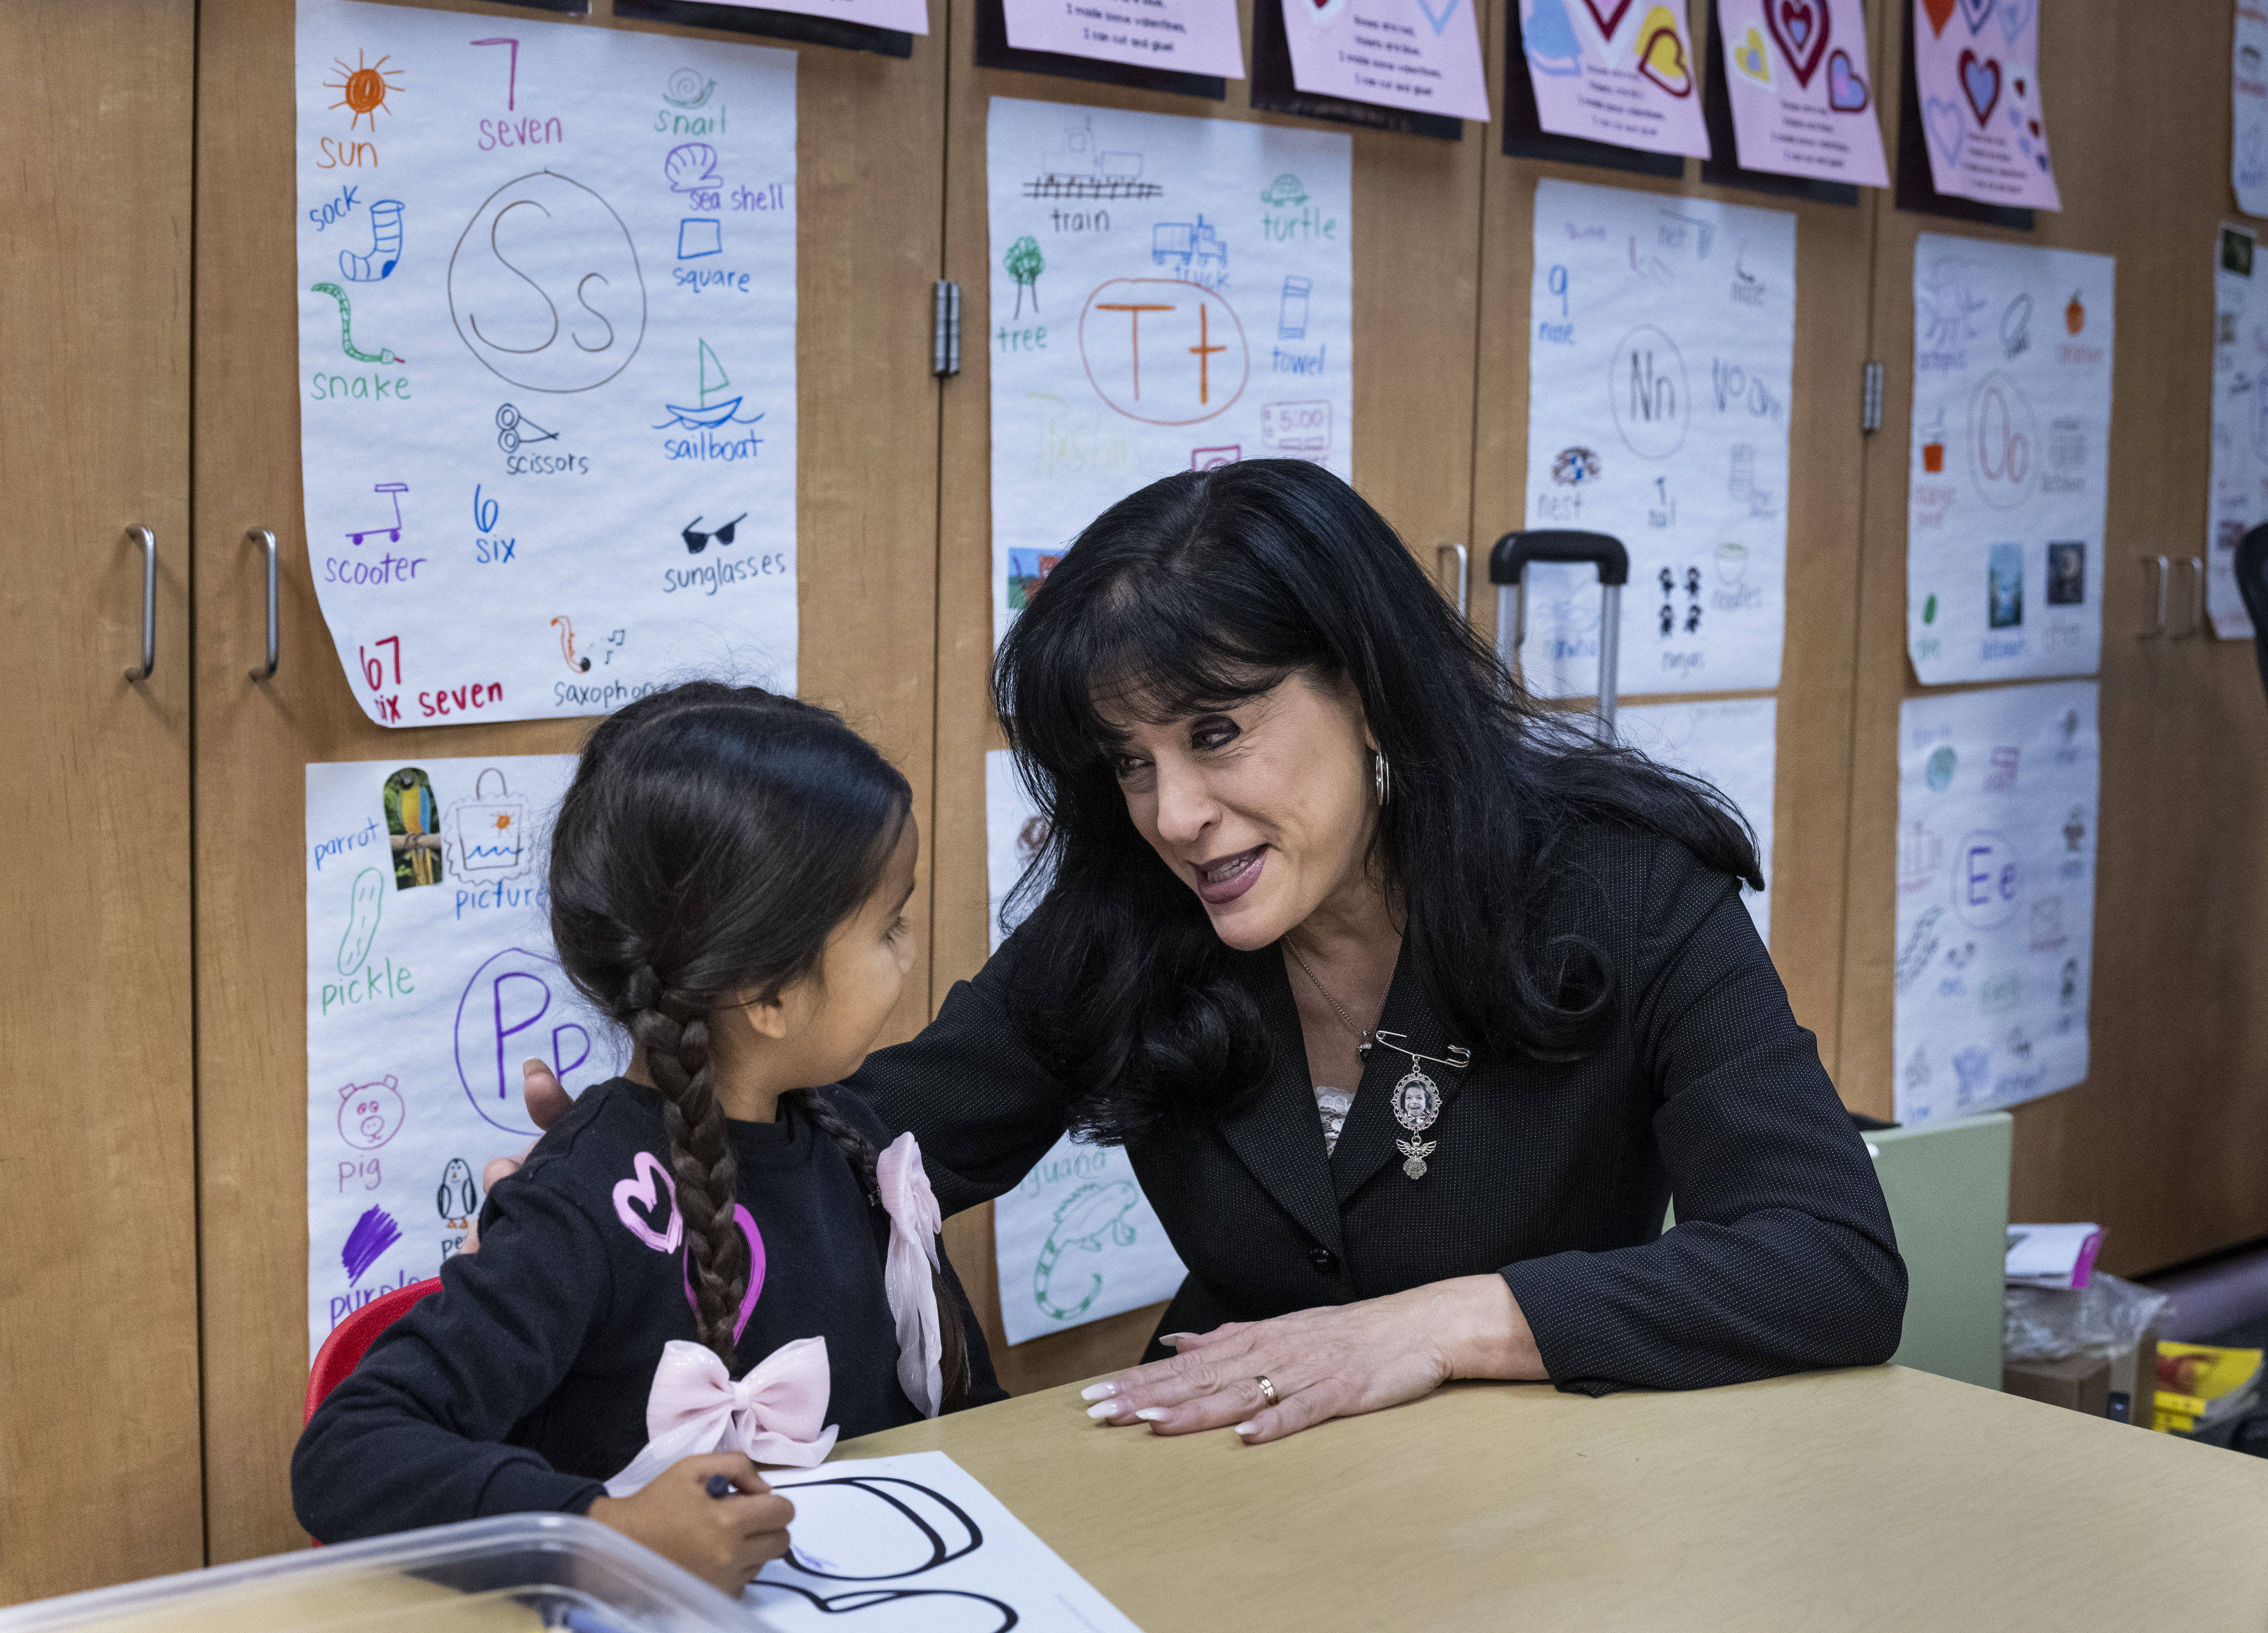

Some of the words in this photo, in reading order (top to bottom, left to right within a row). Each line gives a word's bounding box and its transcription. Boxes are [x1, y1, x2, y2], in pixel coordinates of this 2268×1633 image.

[470, 39, 518, 111] 7
[478, 115, 563, 151] seven
[654, 106, 726, 136] snail
[316, 137, 378, 168] sun
[310, 185, 362, 231] sock
[688, 189, 722, 211] sea
[731, 184, 785, 211] shell
[1050, 207, 1109, 232] train
[1262, 207, 1336, 242] turtle
[470, 201, 614, 354] Ss
[672, 266, 751, 294] square
[997, 325, 1047, 352] tree
[1095, 303, 1227, 404] Tt
[1272, 344, 1325, 376] towel
[311, 373, 411, 400] snake
[1630, 350, 1675, 422] Nn
[664, 429, 763, 460] sailboat
[506, 453, 589, 475] scissors
[475, 484, 498, 532] 6
[476, 537, 515, 564] six
[324, 554, 426, 585] scooter
[663, 552, 786, 595] sunglasses
[360, 635, 401, 691] 67
[418, 681, 502, 717] seven
[314, 817, 380, 871] parrot
[323, 957, 414, 1016] pickle
[494, 972, 590, 1099] Pp
[339, 1154, 382, 1194] pig
[1020, 1149, 1106, 1199] guana
